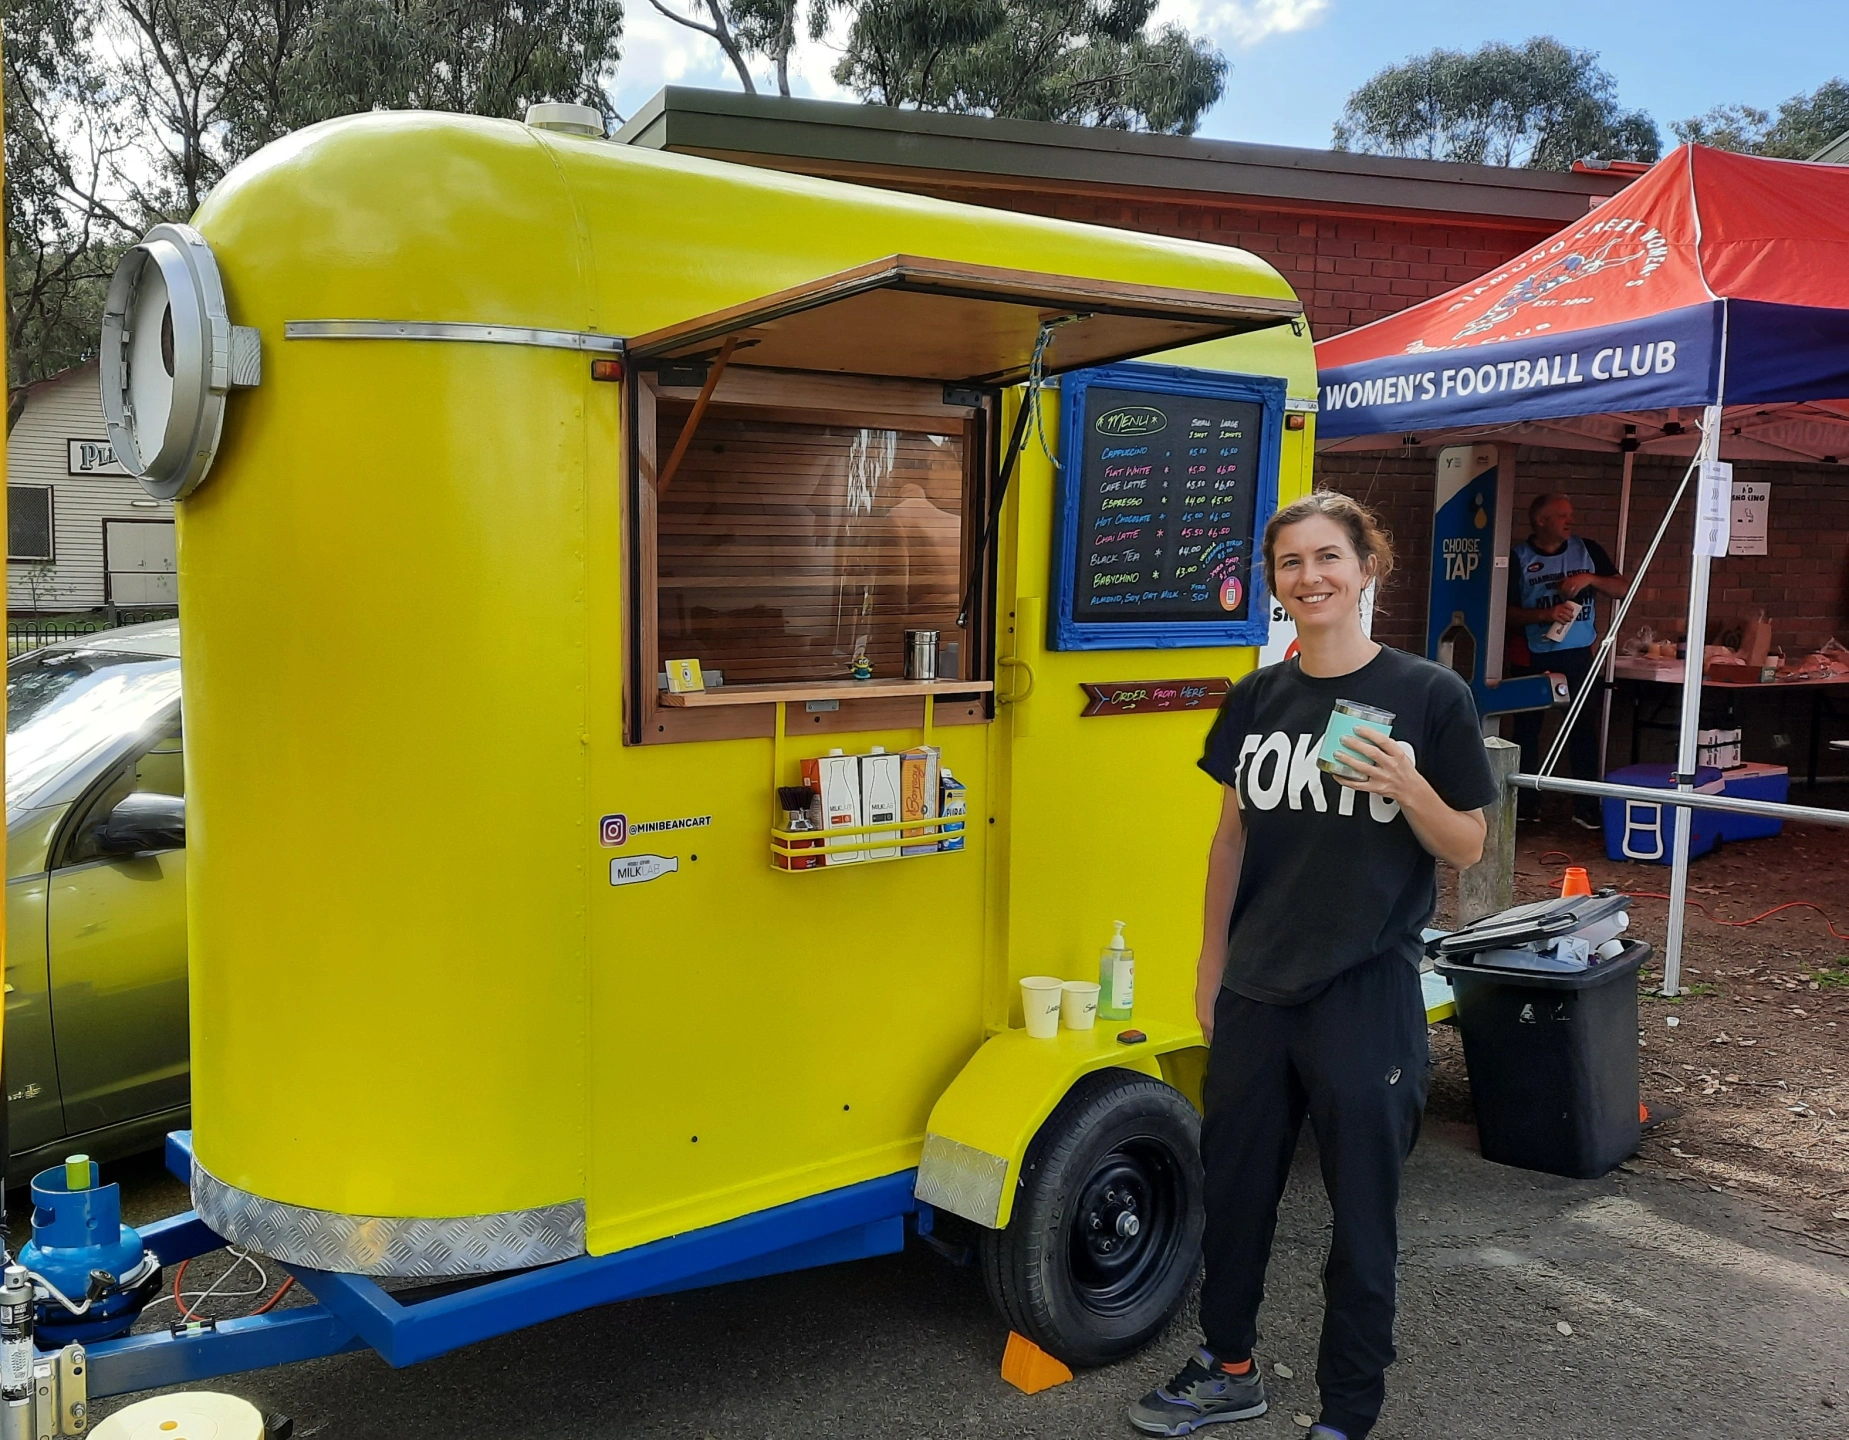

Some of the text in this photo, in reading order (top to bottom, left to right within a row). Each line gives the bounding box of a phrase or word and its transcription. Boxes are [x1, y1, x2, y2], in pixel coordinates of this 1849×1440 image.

[1574, 217, 1646, 240] CREEK
[1325, 340, 1677, 411] WOMEN'S FOOTBALL CLUB
[1107, 413, 1150, 432] MENU
[1101, 446, 1148, 460] CAPPUCCINO
[1104, 465, 1152, 477] FLAT WHITE
[1123, 479, 1148, 490] LATTE
[1101, 498, 1143, 511] ESPRESSO
[1185, 495, 1233, 507] $4.00 $5.00
[1094, 513, 1152, 530] HOT CHOCOLATE
[1182, 512, 1231, 522] $5.00 $6.00
[1116, 529, 1141, 541] LATTE
[1181, 527, 1230, 538] $5.50 $6.50
[1178, 545, 1201, 557] $4.00
[1442, 537, 1480, 553] CHOOSE
[1090, 548, 1140, 566] BLACK TEA
[1175, 565, 1198, 578] $3.00
[1443, 553, 1479, 581] TAP
[1093, 572, 1140, 588] BABYCHINO
[1161, 589, 1179, 599] MILK
[1111, 686, 1207, 704] ORDER FROM HERE
[1234, 730, 1417, 824] TOKO
[629, 816, 711, 835] @MINIBEANCART
[617, 863, 660, 879] MILKLAB
